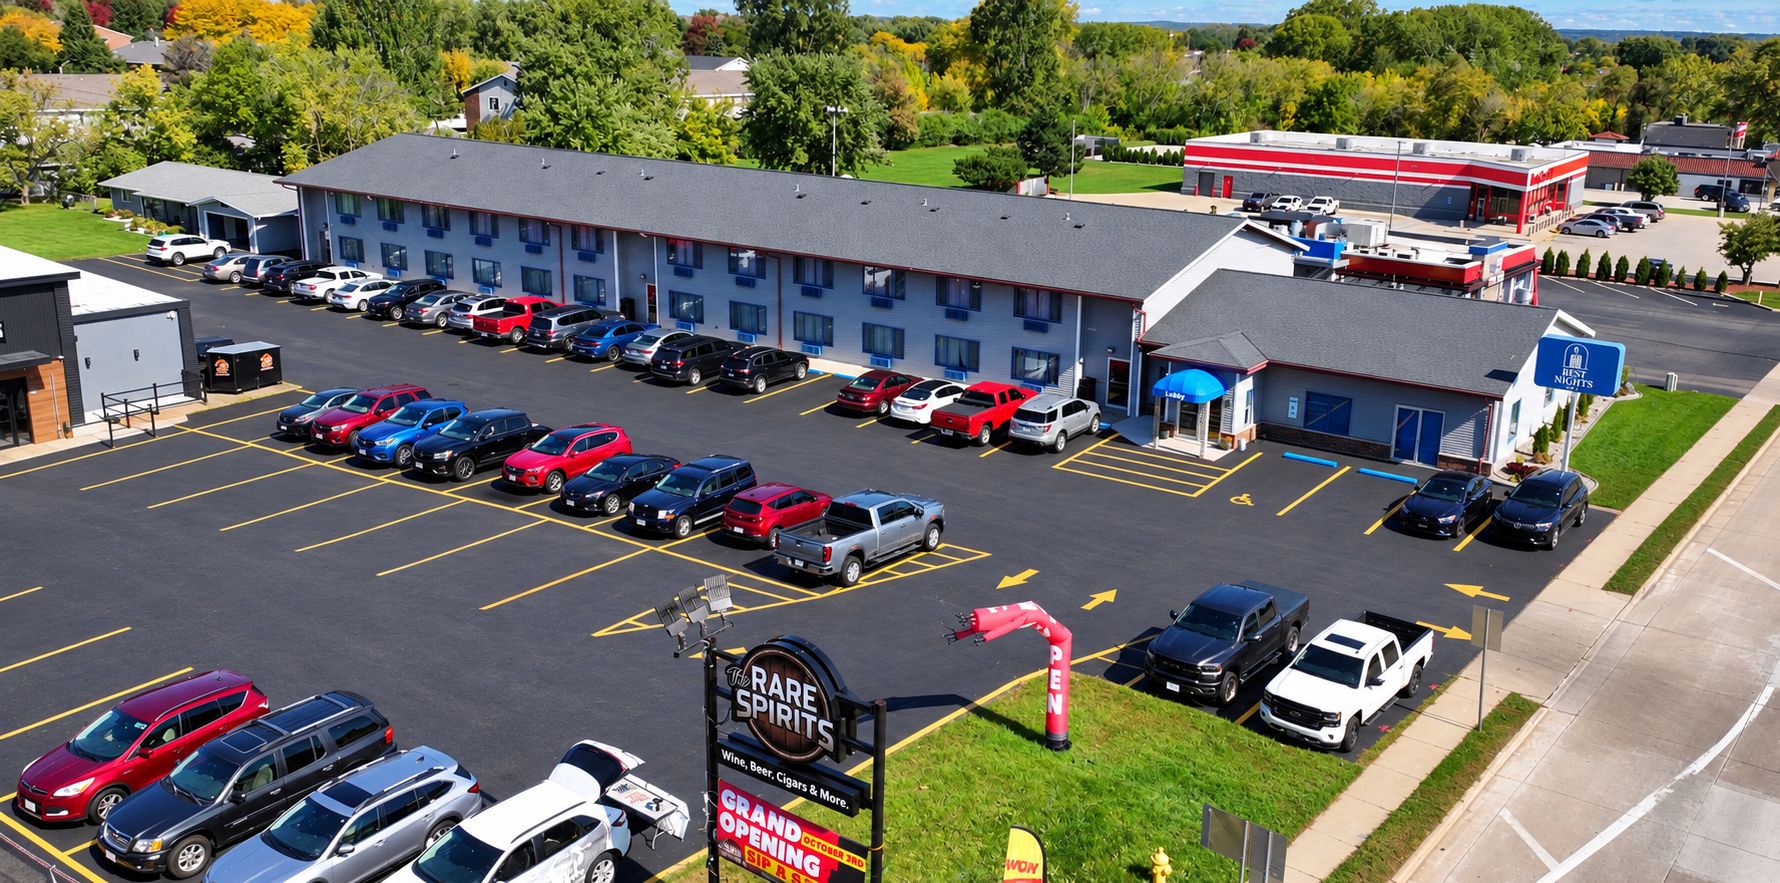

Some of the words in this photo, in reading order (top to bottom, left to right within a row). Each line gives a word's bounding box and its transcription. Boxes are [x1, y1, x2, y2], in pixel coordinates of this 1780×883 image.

[1554, 375, 1593, 388] NIGHTS
[727, 666, 751, 687] The
[751, 665, 817, 713] RARE
[736, 688, 834, 752] SPIRITS
[721, 749, 748, 770] Wine,
[776, 772, 807, 792] Cigars
[809, 785, 818, 797] &
[820, 788, 849, 810] More.
[721, 789, 802, 843] GRAND
[719, 811, 821, 877] OPENING
[747, 850, 771, 868] SIP
[804, 836, 843, 859] OCTOBER
[846, 855, 864, 868] 3RD
